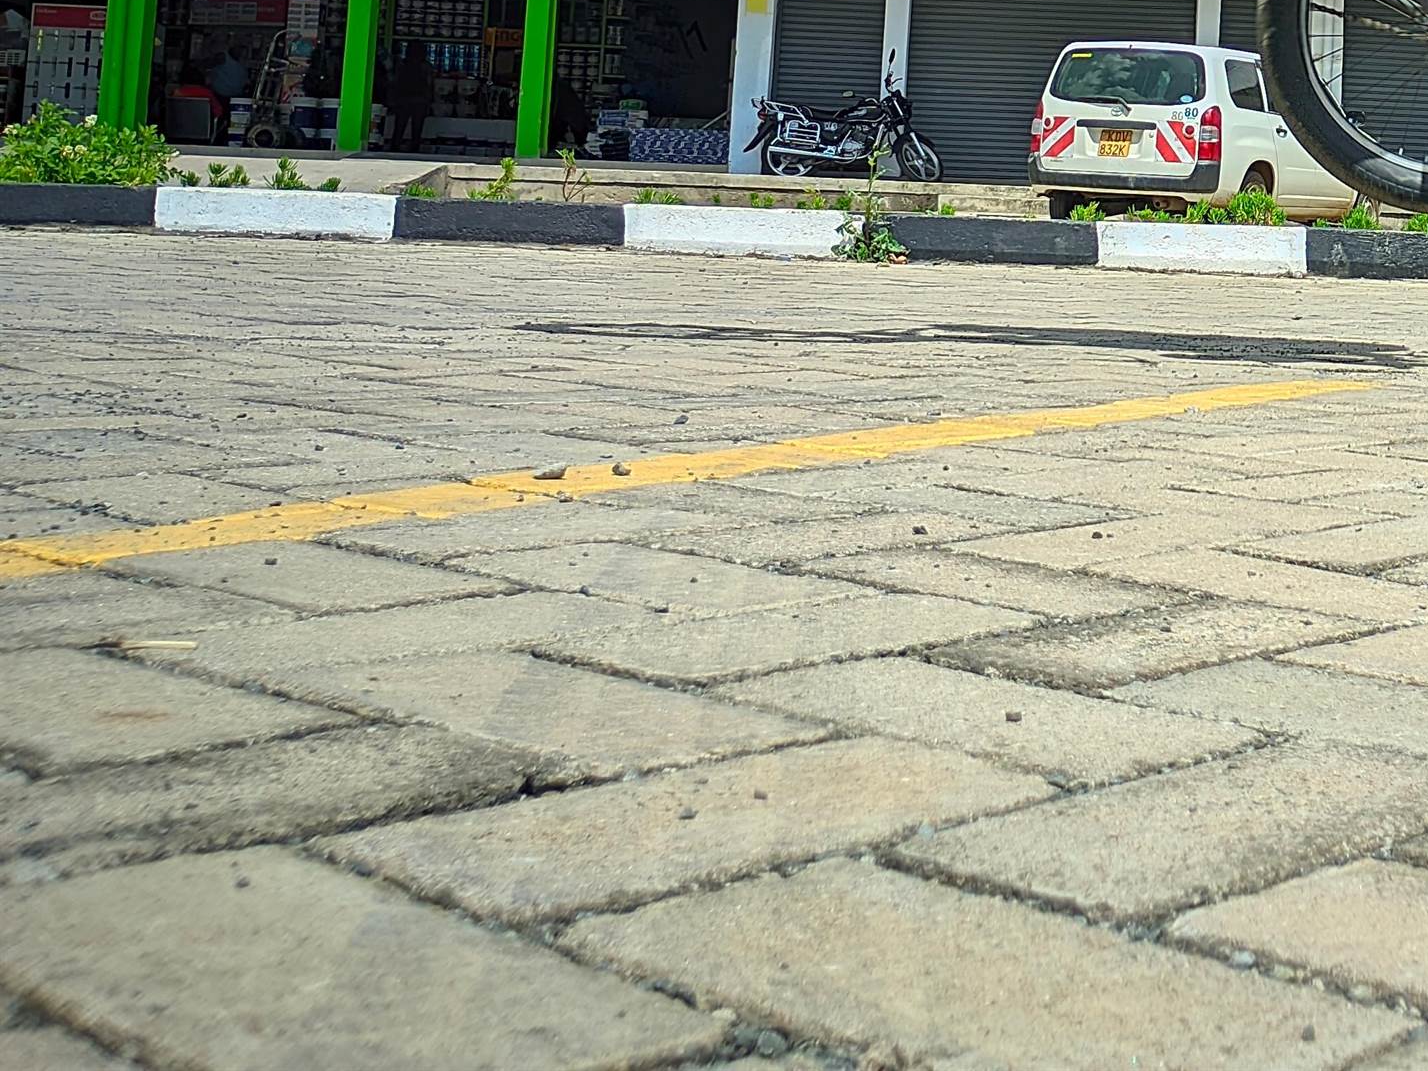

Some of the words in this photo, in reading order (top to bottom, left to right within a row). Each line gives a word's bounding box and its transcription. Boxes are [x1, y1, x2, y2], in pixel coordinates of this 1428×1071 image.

[1171, 111, 1184, 120] 80
[1184, 107, 1199, 117] 80
[1107, 130, 1130, 142] KDV
[1100, 143, 1127, 156] 832K
